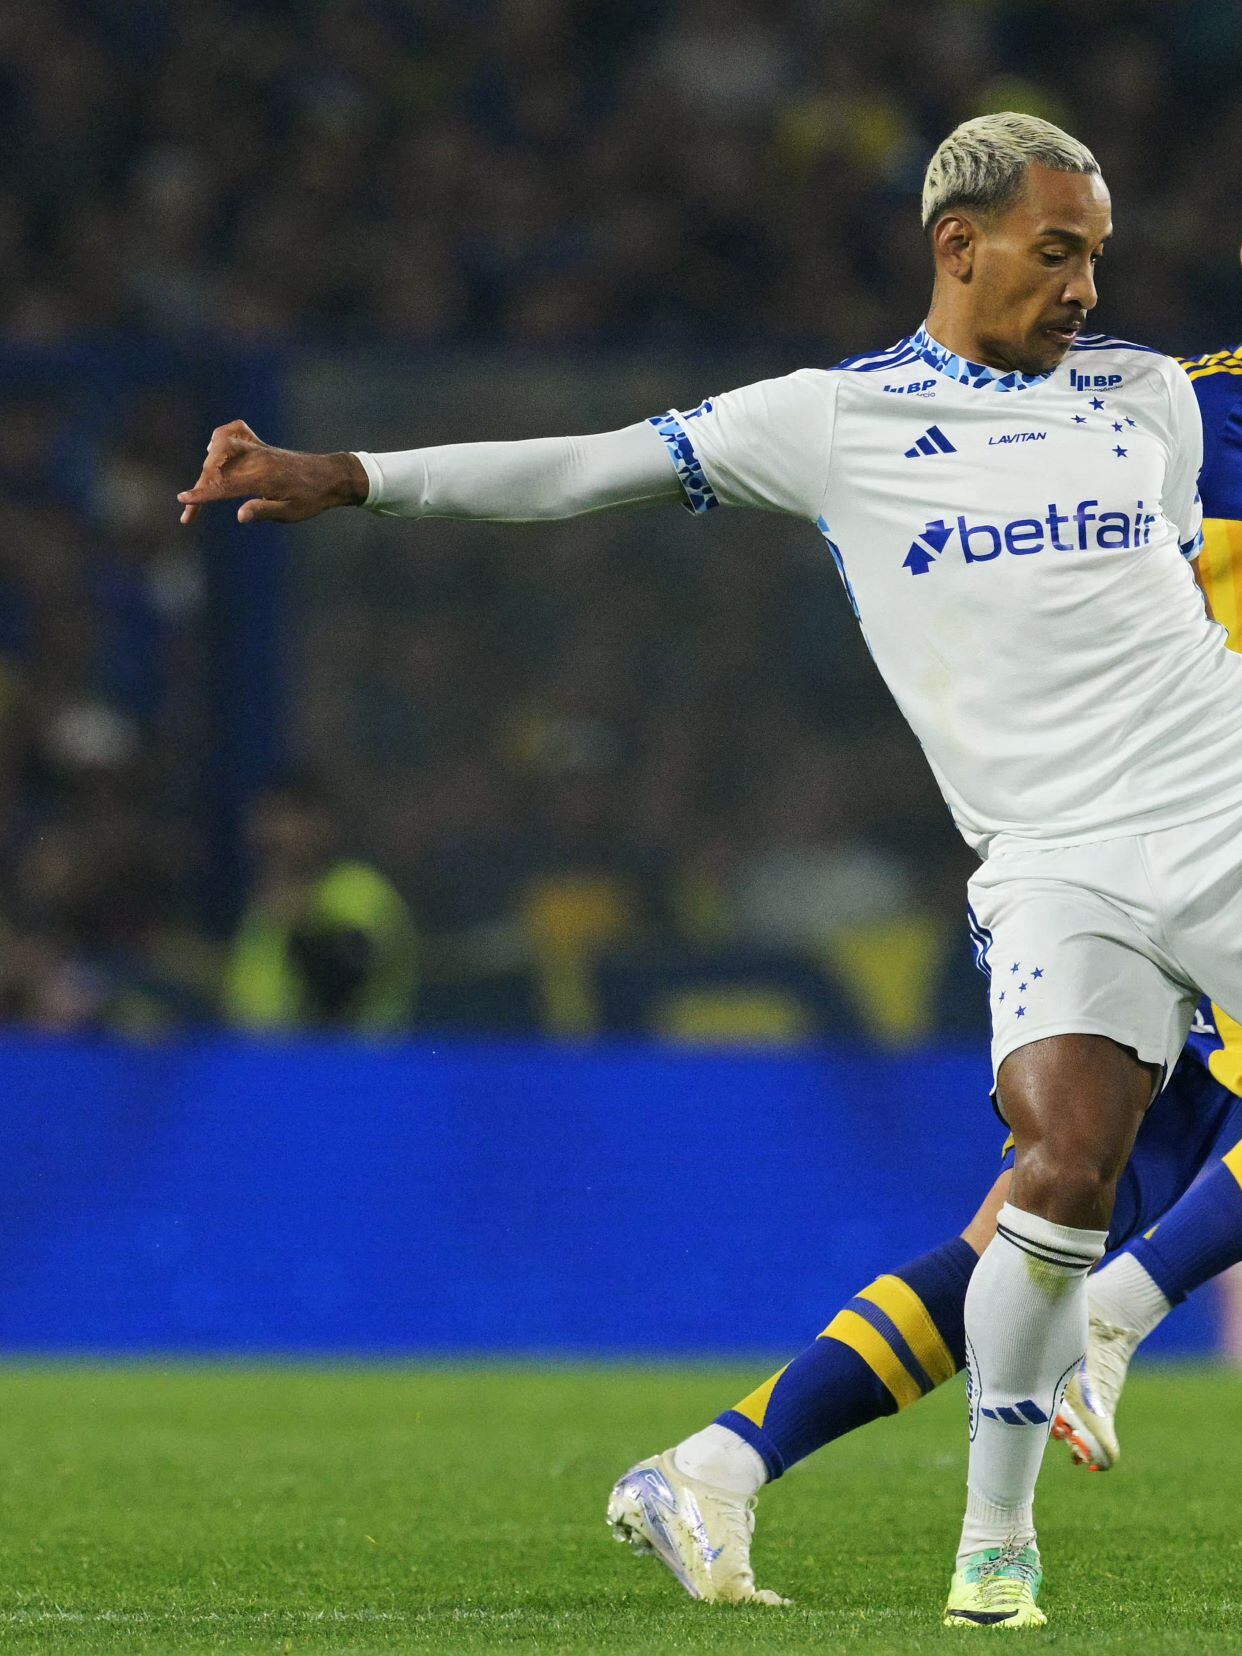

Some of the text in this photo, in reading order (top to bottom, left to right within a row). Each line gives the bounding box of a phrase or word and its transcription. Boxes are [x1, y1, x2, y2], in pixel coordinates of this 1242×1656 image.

[907, 379, 937, 394] BP
[1093, 374, 1123, 387] BP
[988, 432, 1047, 445] LAVITAN
[957, 500, 1156, 564] betfair
